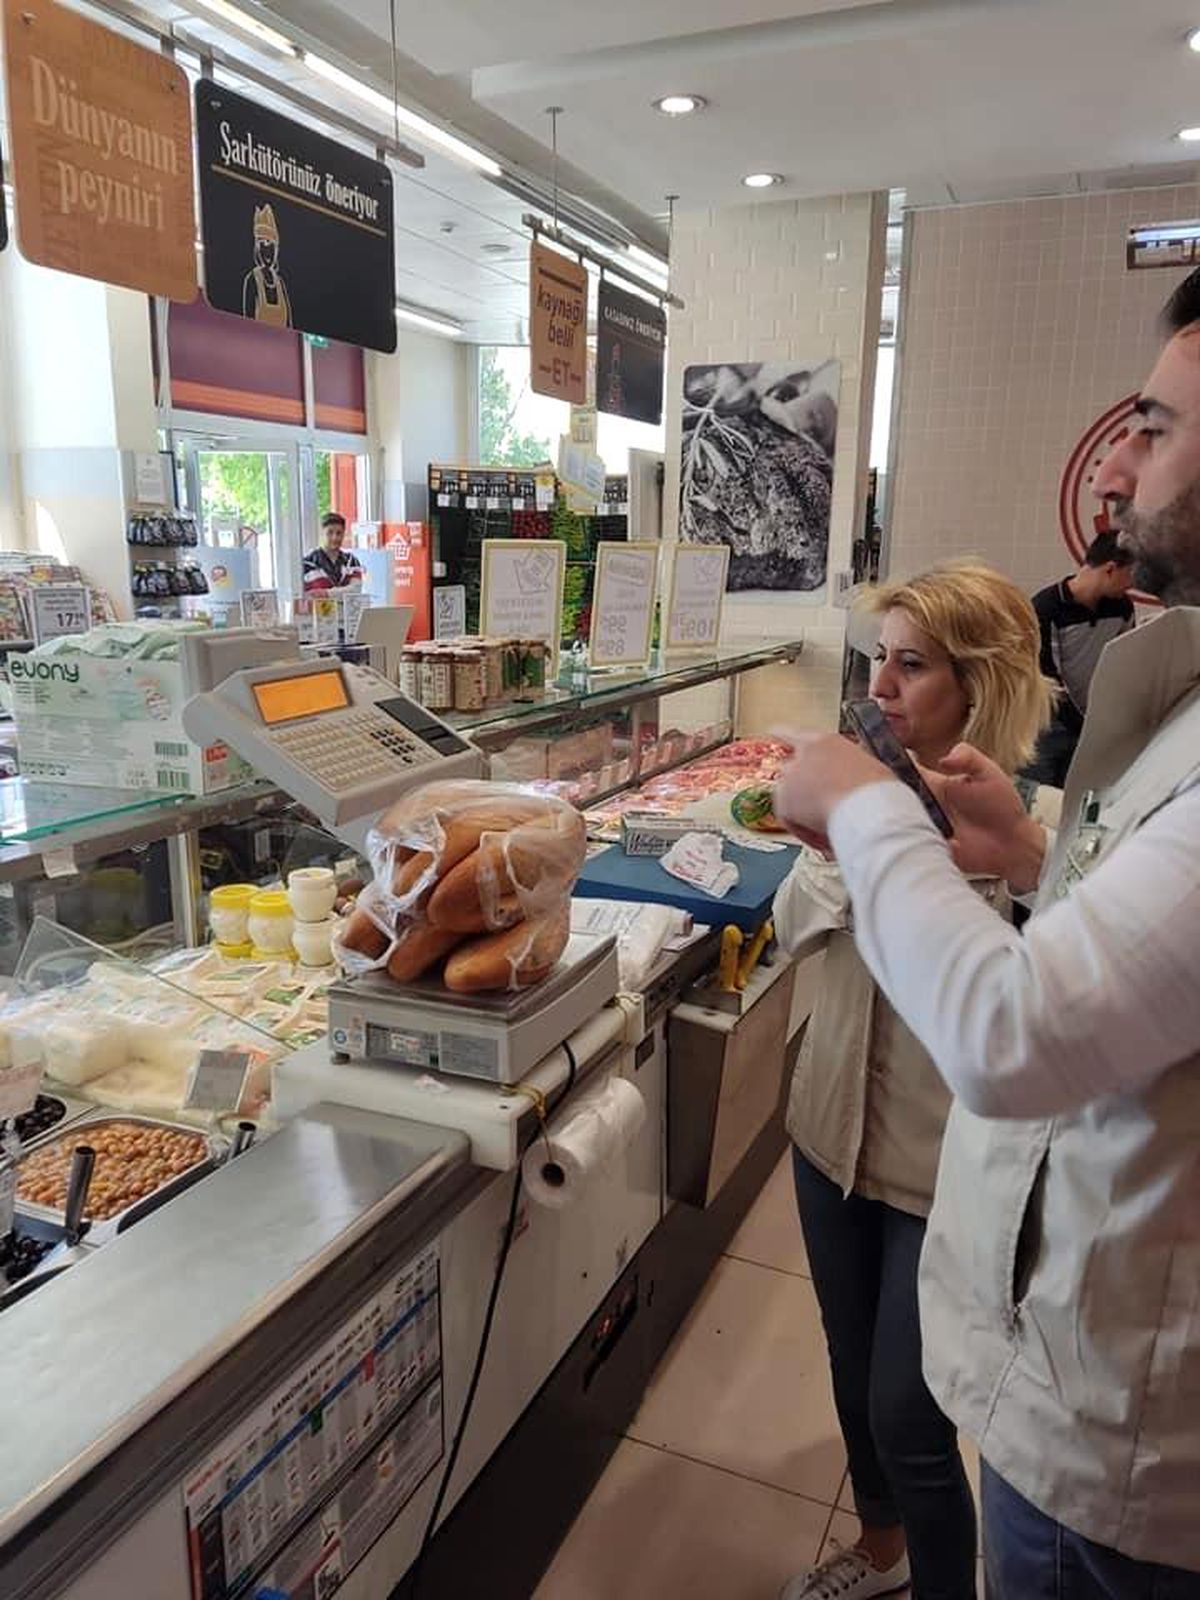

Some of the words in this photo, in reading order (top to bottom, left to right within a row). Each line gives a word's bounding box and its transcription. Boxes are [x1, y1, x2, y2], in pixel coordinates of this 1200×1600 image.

[29, 56, 180, 175] Dünyanın
[57, 160, 165, 231] peyniri
[219, 120, 321, 196] Şarkütörünüz
[325, 174, 380, 221] öneriyor
[548, 320, 575, 348] belli
